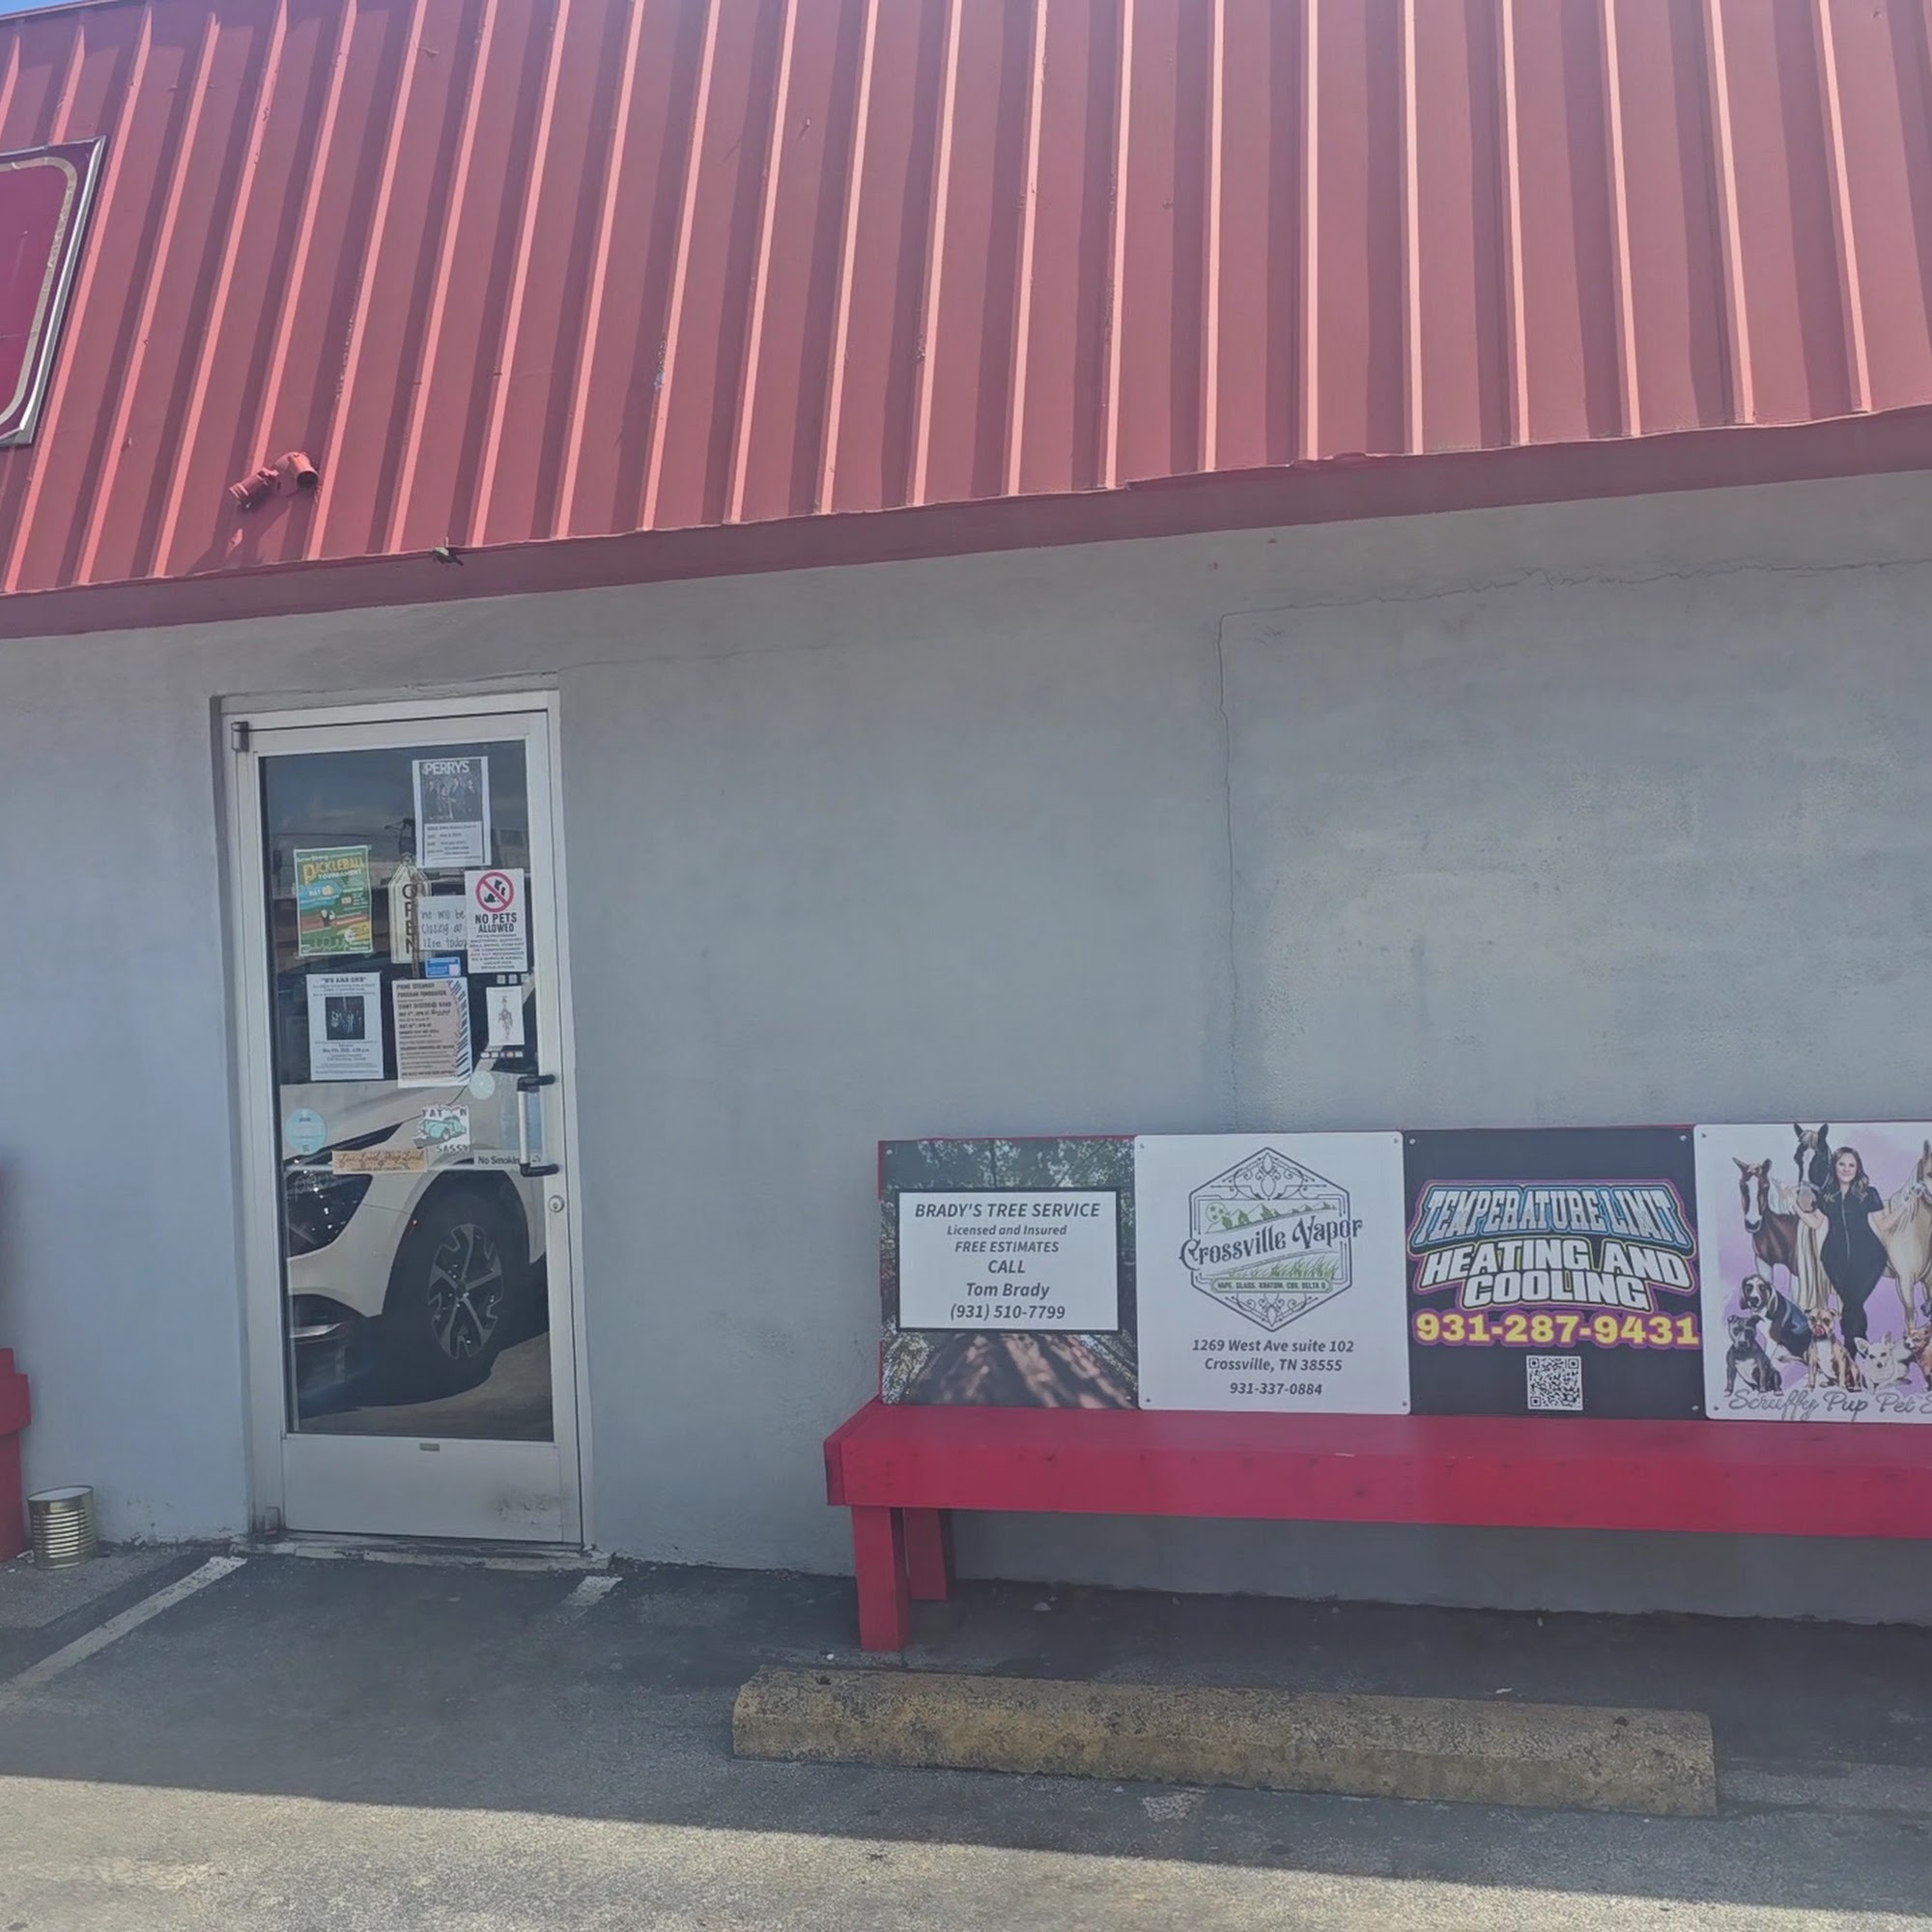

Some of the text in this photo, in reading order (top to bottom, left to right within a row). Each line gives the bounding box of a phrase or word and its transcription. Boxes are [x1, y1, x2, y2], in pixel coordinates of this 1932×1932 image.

[303, 857, 365, 886] PICKLEBALL
[402, 883, 418, 954] OPEN
[475, 912, 518, 923] NO PETS
[478, 923, 515, 933] ALLOWED
[491, 1155, 520, 1165] Smokin
[915, 1203, 1100, 1217] BRADY'S TREE SERVICE
[947, 1225, 1067, 1236] Licensed and Insured
[954, 1241, 1059, 1252] FREE ESTIMATES
[1179, 1215, 1363, 1271] Crossville Vapor
[987, 1260, 1026, 1274] CALL
[1419, 1238, 1691, 1289] HEATING AND
[966, 1283, 1050, 1300] Tom Brady
[1463, 1270, 1652, 1311] COOLING
[950, 1304, 1065, 1321] (931) 510-7799
[1415, 1314, 1700, 1345] 931-287-9431
[1192, 1339, 1354, 1352] 1269 West Ave suite 102
[1205, 1357, 1343, 1373] Crossville, TN 38555
[1230, 1382, 1322, 1396] 931-337-0884
[1728, 1388, 1820, 1422] Scruffy
[1823, 1391, 1869, 1422] Pup
[1875, 1392, 1917, 1413] Pet
